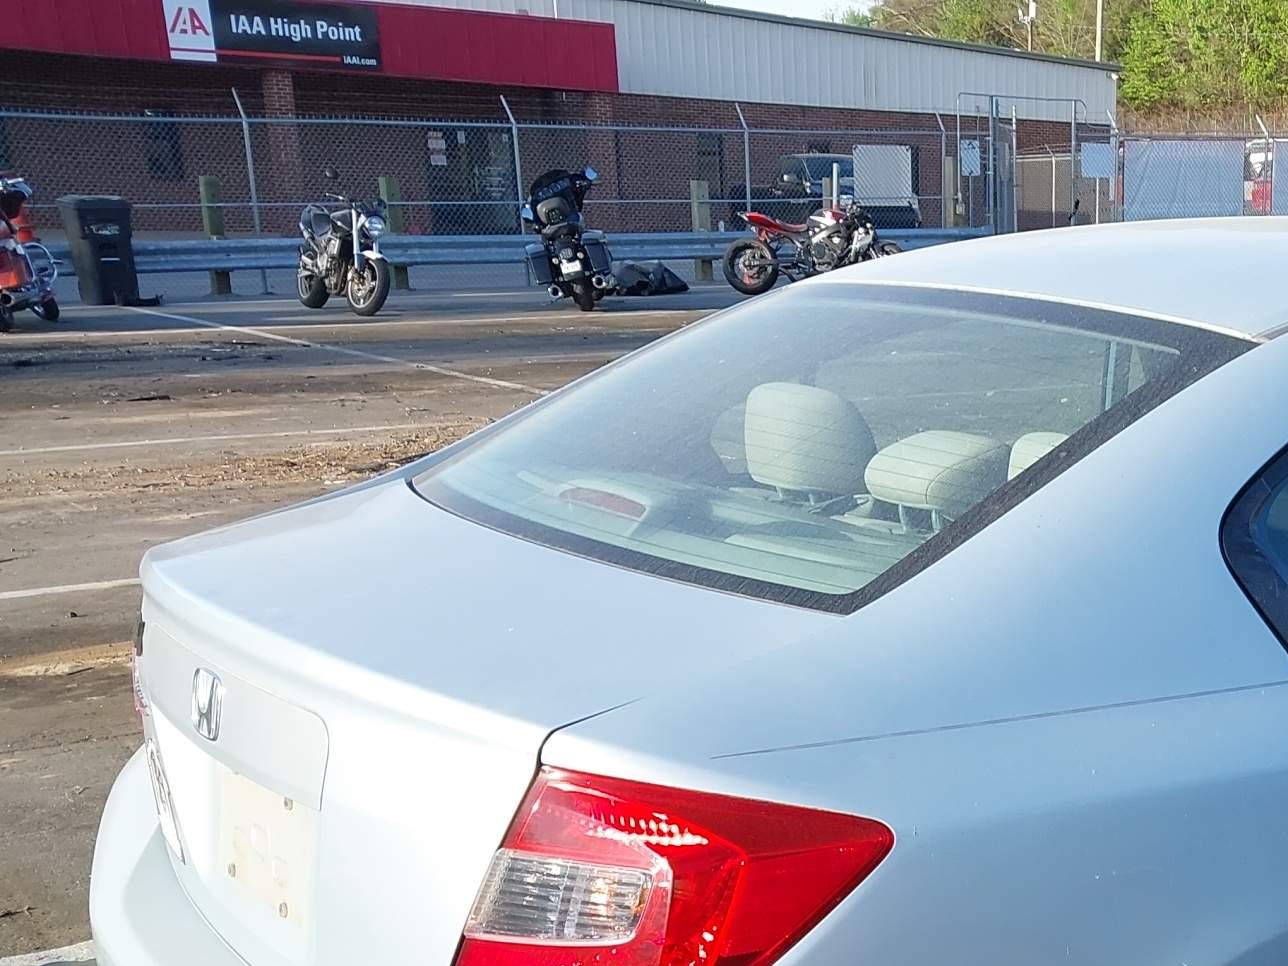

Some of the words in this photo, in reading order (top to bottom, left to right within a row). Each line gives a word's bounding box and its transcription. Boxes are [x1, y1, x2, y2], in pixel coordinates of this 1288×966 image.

[230, 14, 266, 35] IAA
[269, 17, 312, 42] High
[316, 20, 362, 42] Point
